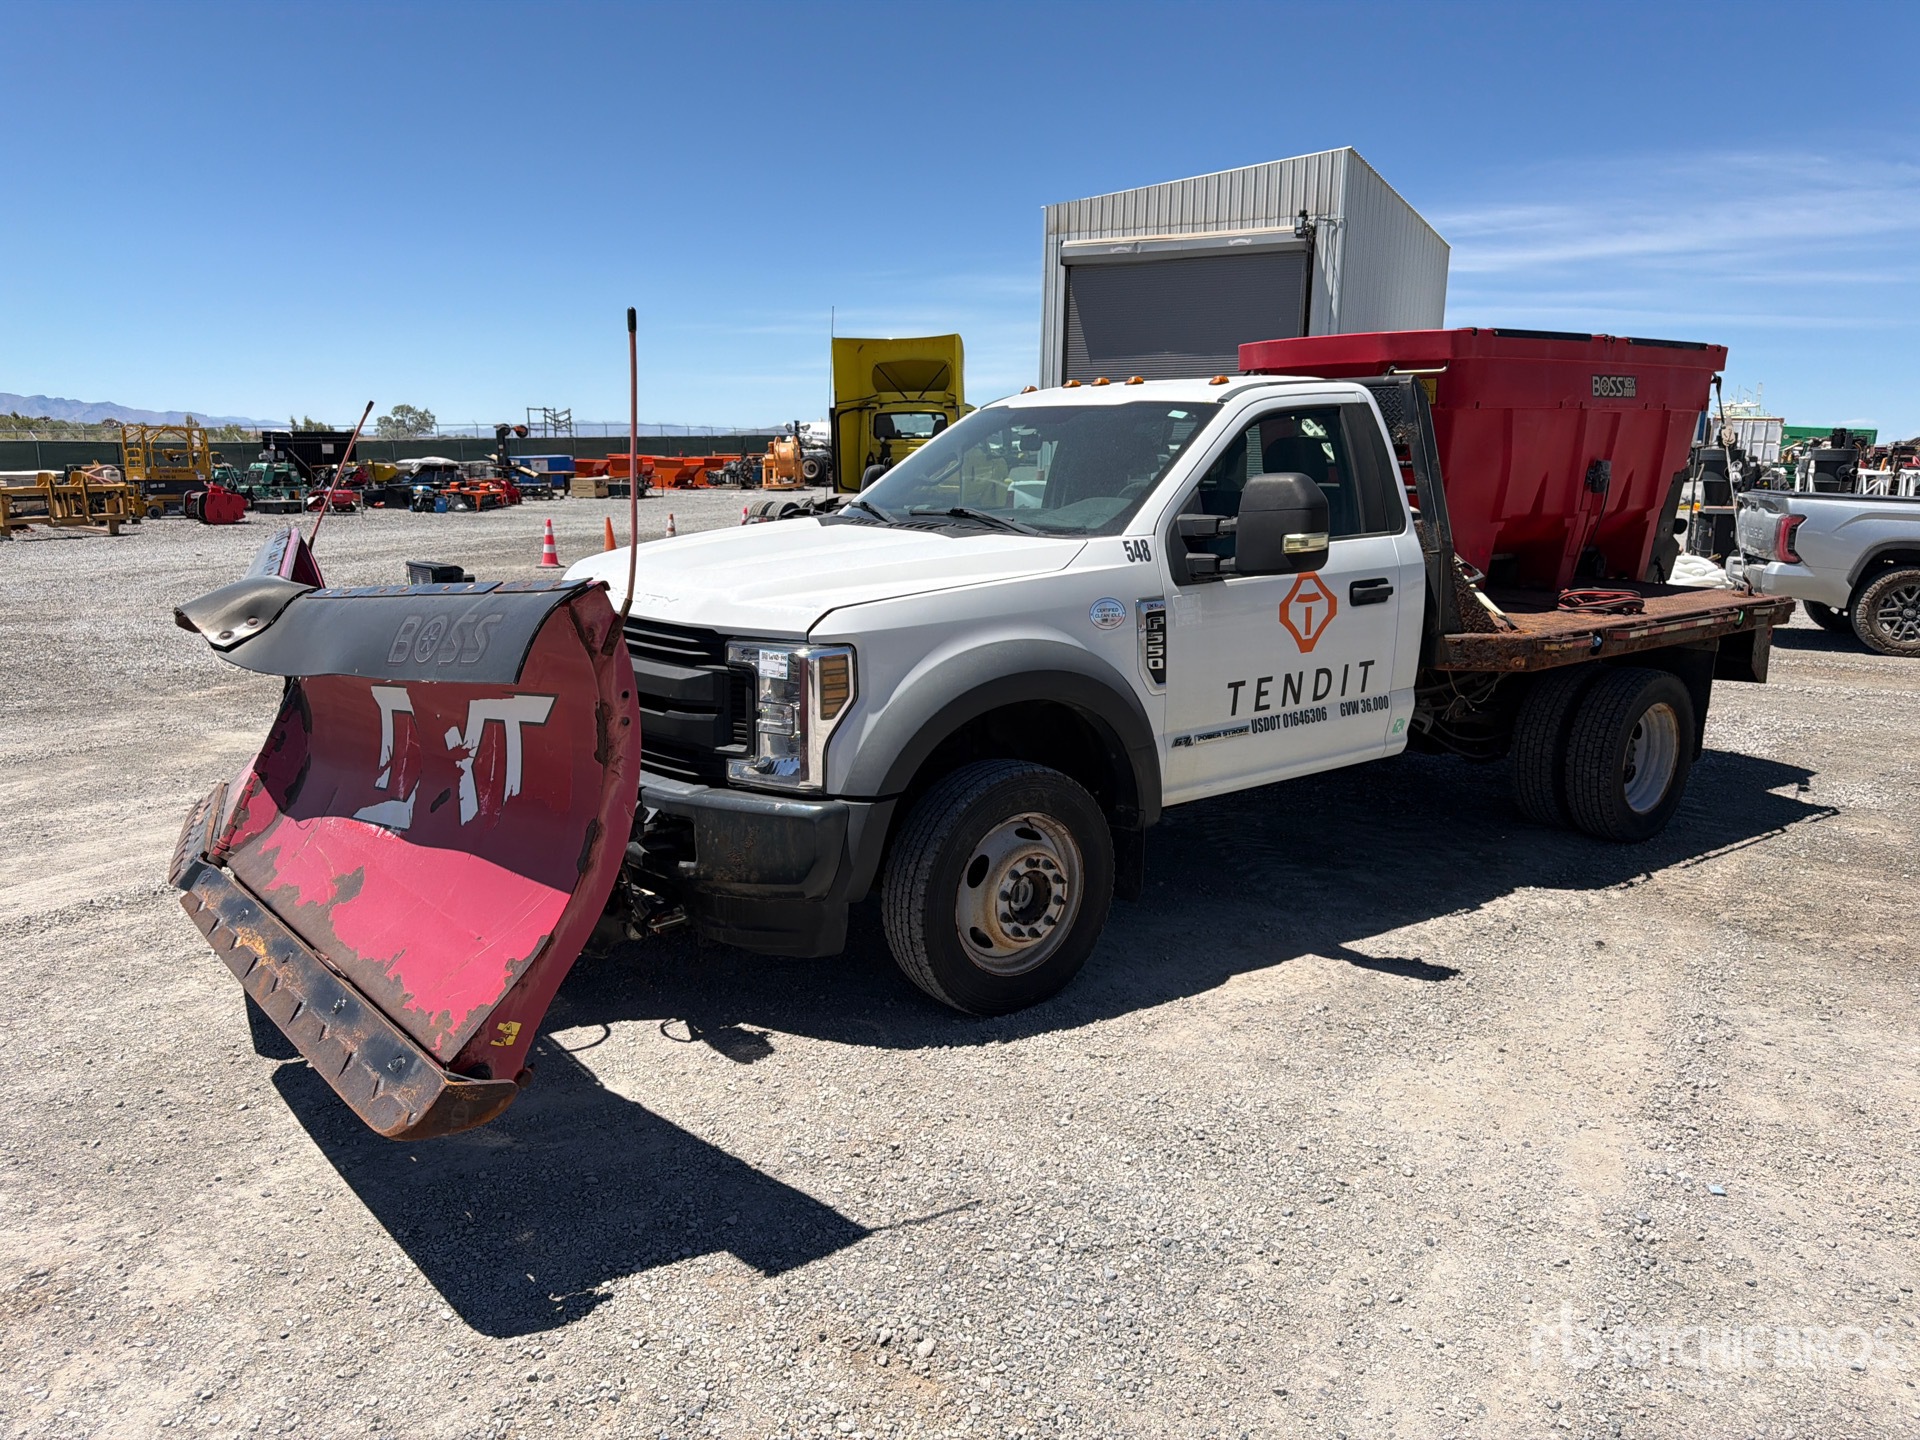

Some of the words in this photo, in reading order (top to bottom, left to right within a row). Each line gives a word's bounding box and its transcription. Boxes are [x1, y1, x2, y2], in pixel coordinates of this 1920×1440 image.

[1592, 376, 1624, 397] BOSS
[1122, 538, 1152, 563] 548
[386, 613, 504, 666] BOSS
[1227, 659, 1375, 716] TENDIT
[1250, 714, 1281, 734] USDOT
[1282, 706, 1328, 729] 01646306
[1339, 700, 1360, 718] GVW
[1360, 695, 1389, 714] 36,000
[1222, 726, 1250, 737] STROKE
